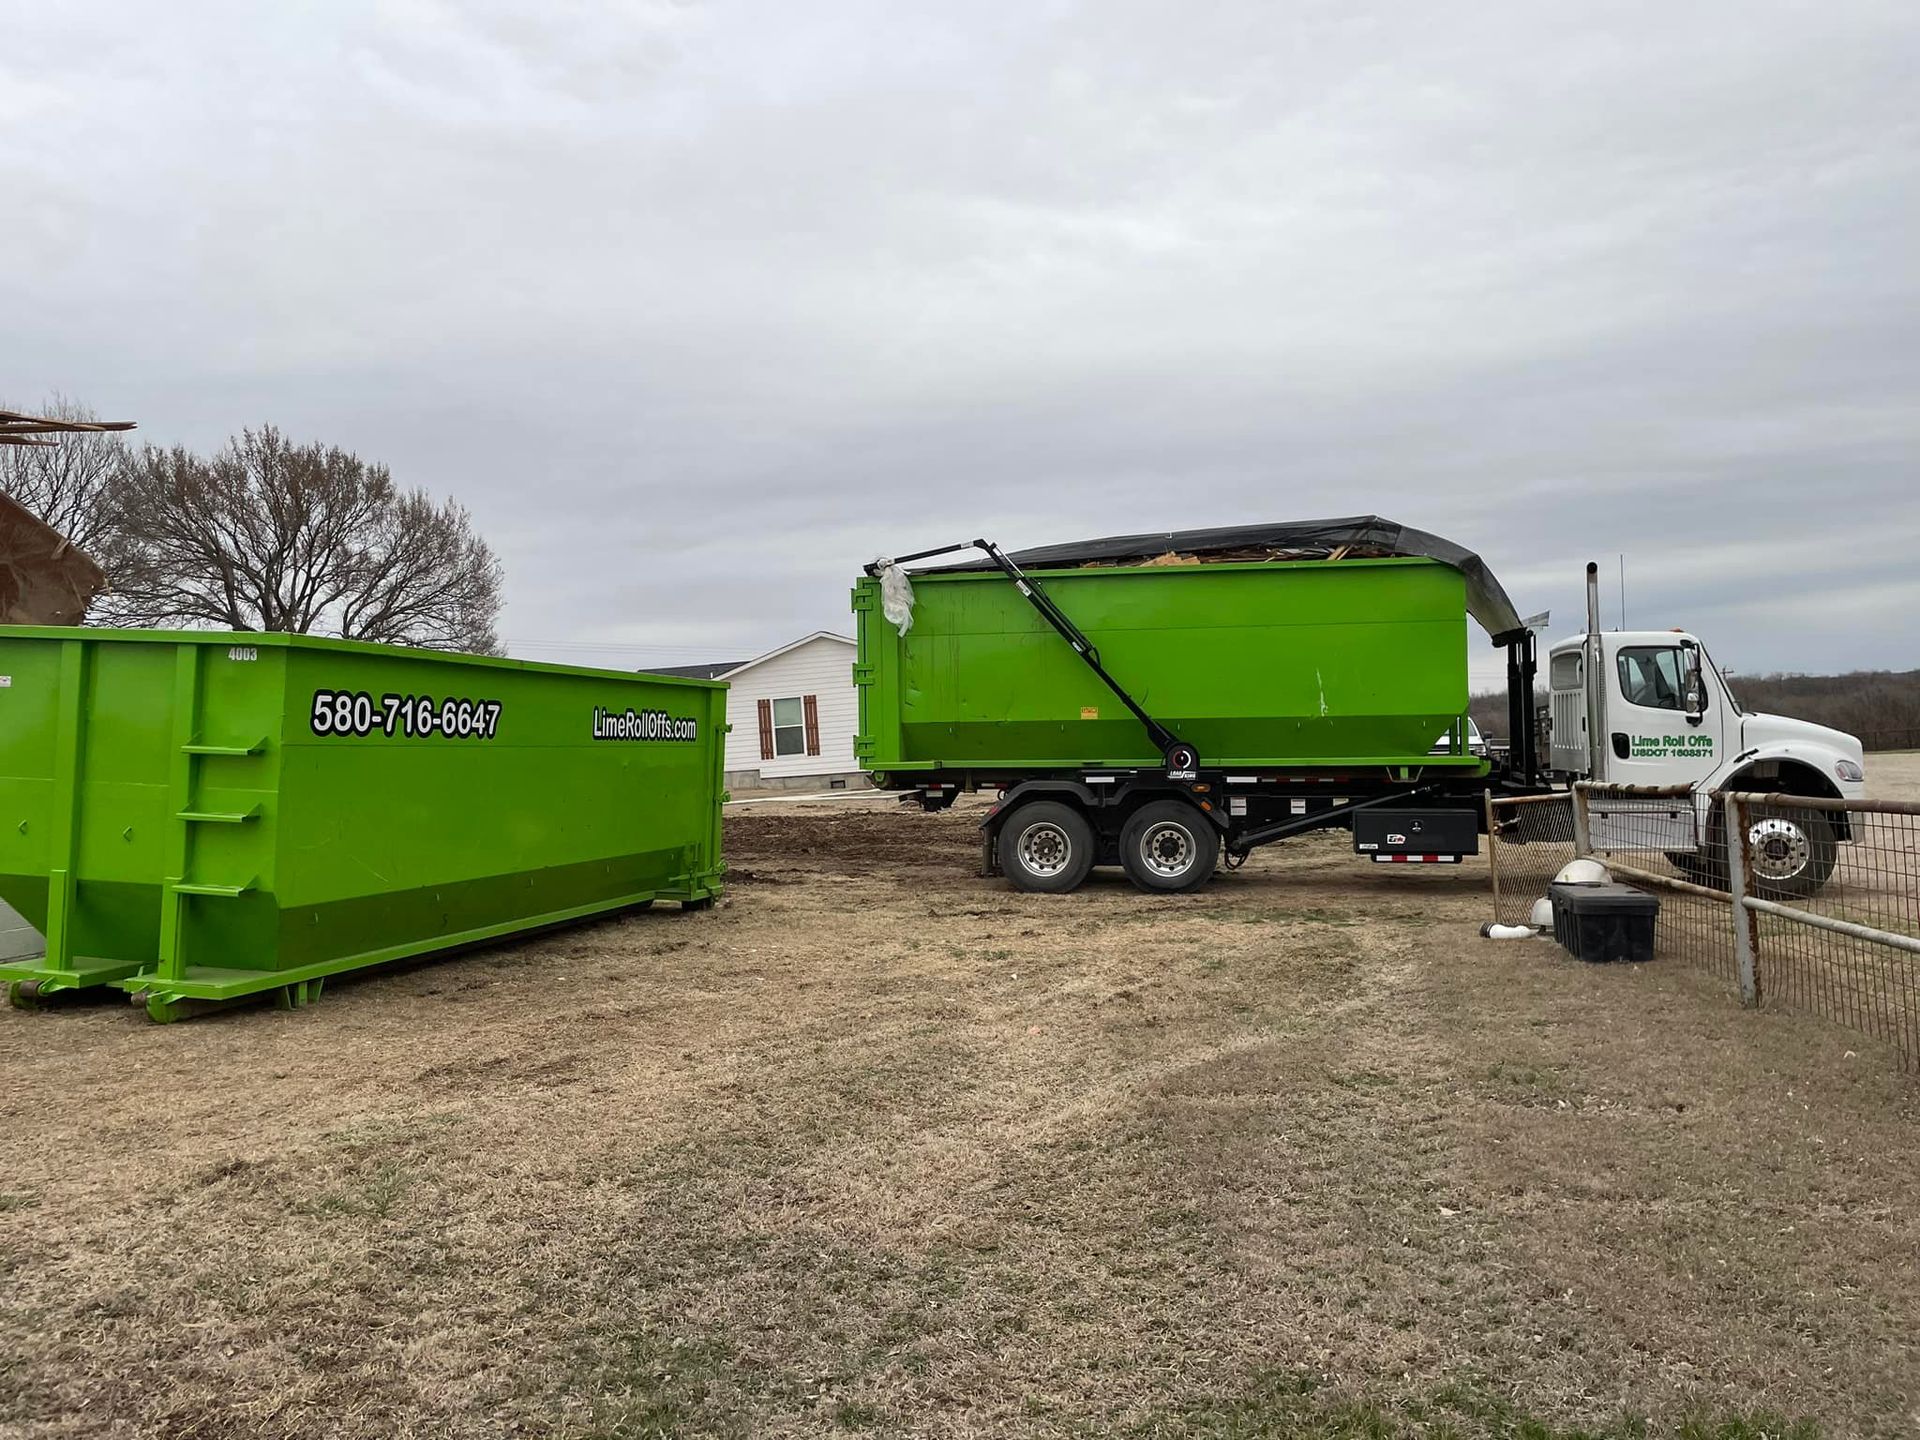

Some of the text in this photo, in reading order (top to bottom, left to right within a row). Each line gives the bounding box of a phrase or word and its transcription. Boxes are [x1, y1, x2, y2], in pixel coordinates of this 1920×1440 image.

[228, 647, 258, 661] 4003
[312, 692, 501, 736] 580-716-6647
[593, 708, 697, 740] LimeRollOffs.com
[1632, 735, 1713, 747] Lime Roll Offs
[1632, 748, 1668, 757] USDOT
